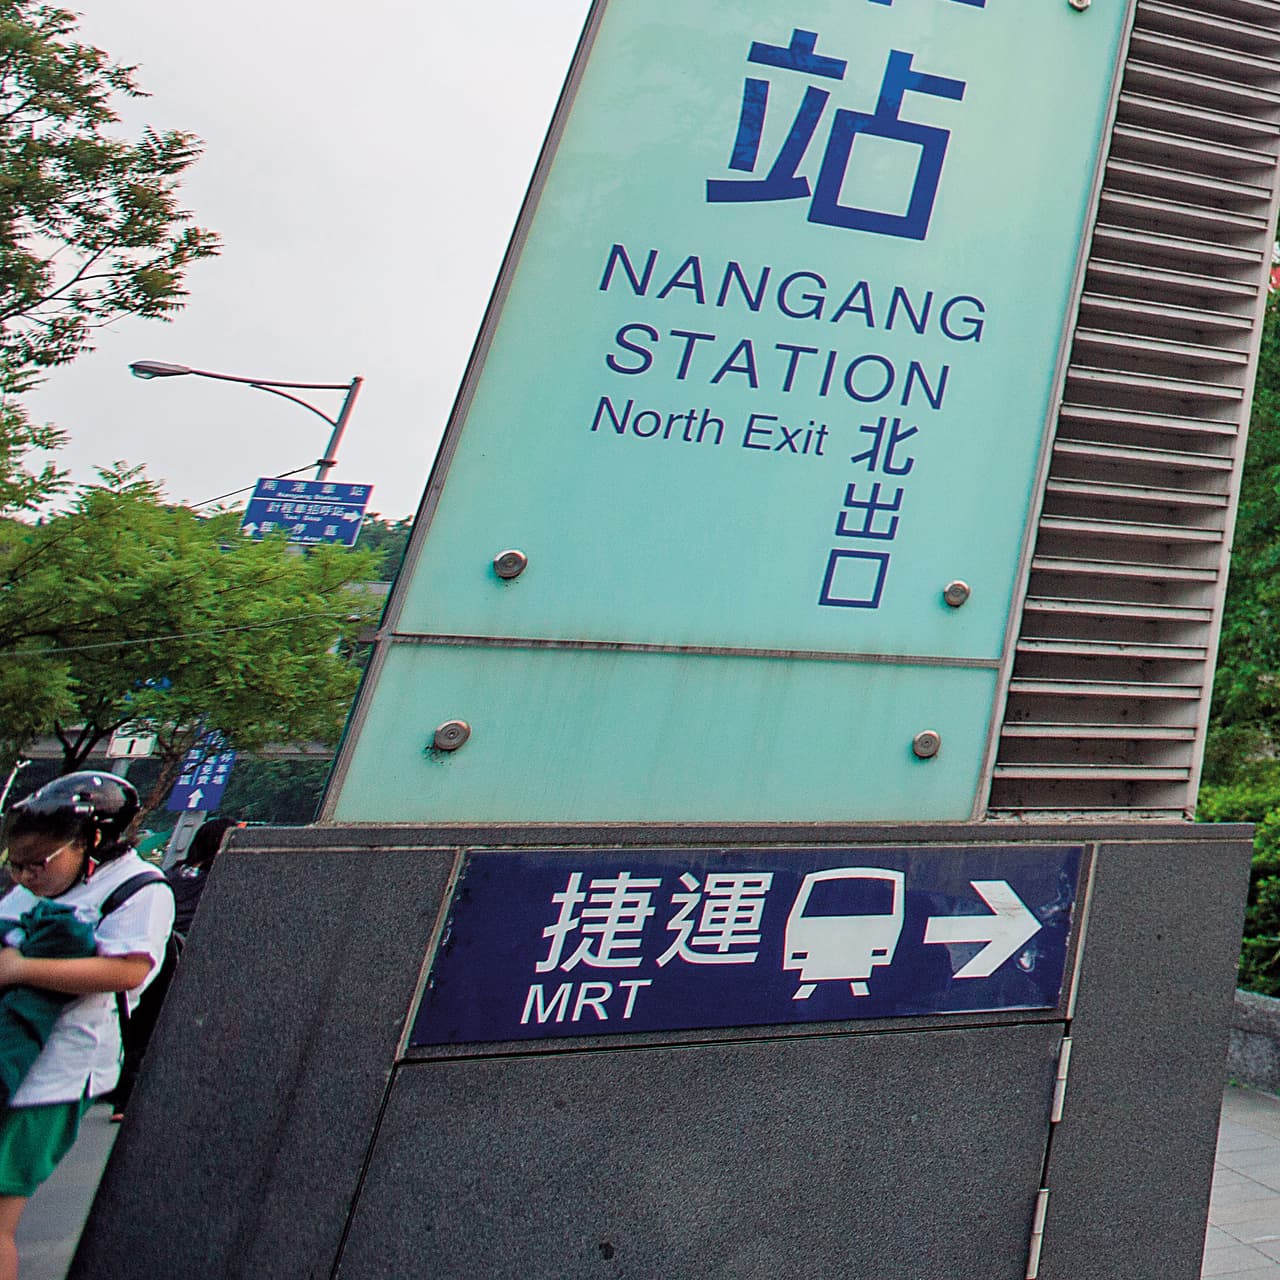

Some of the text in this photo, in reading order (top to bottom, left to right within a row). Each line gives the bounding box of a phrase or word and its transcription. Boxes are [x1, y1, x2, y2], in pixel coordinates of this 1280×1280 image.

[599, 244, 985, 343] NANGANG
[605, 323, 949, 410] STATION
[590, 396, 829, 456] North Exit
[818, 415, 919, 609] 北出口
[535, 871, 774, 973] 捷運
[520, 979, 652, 1025] MRT
